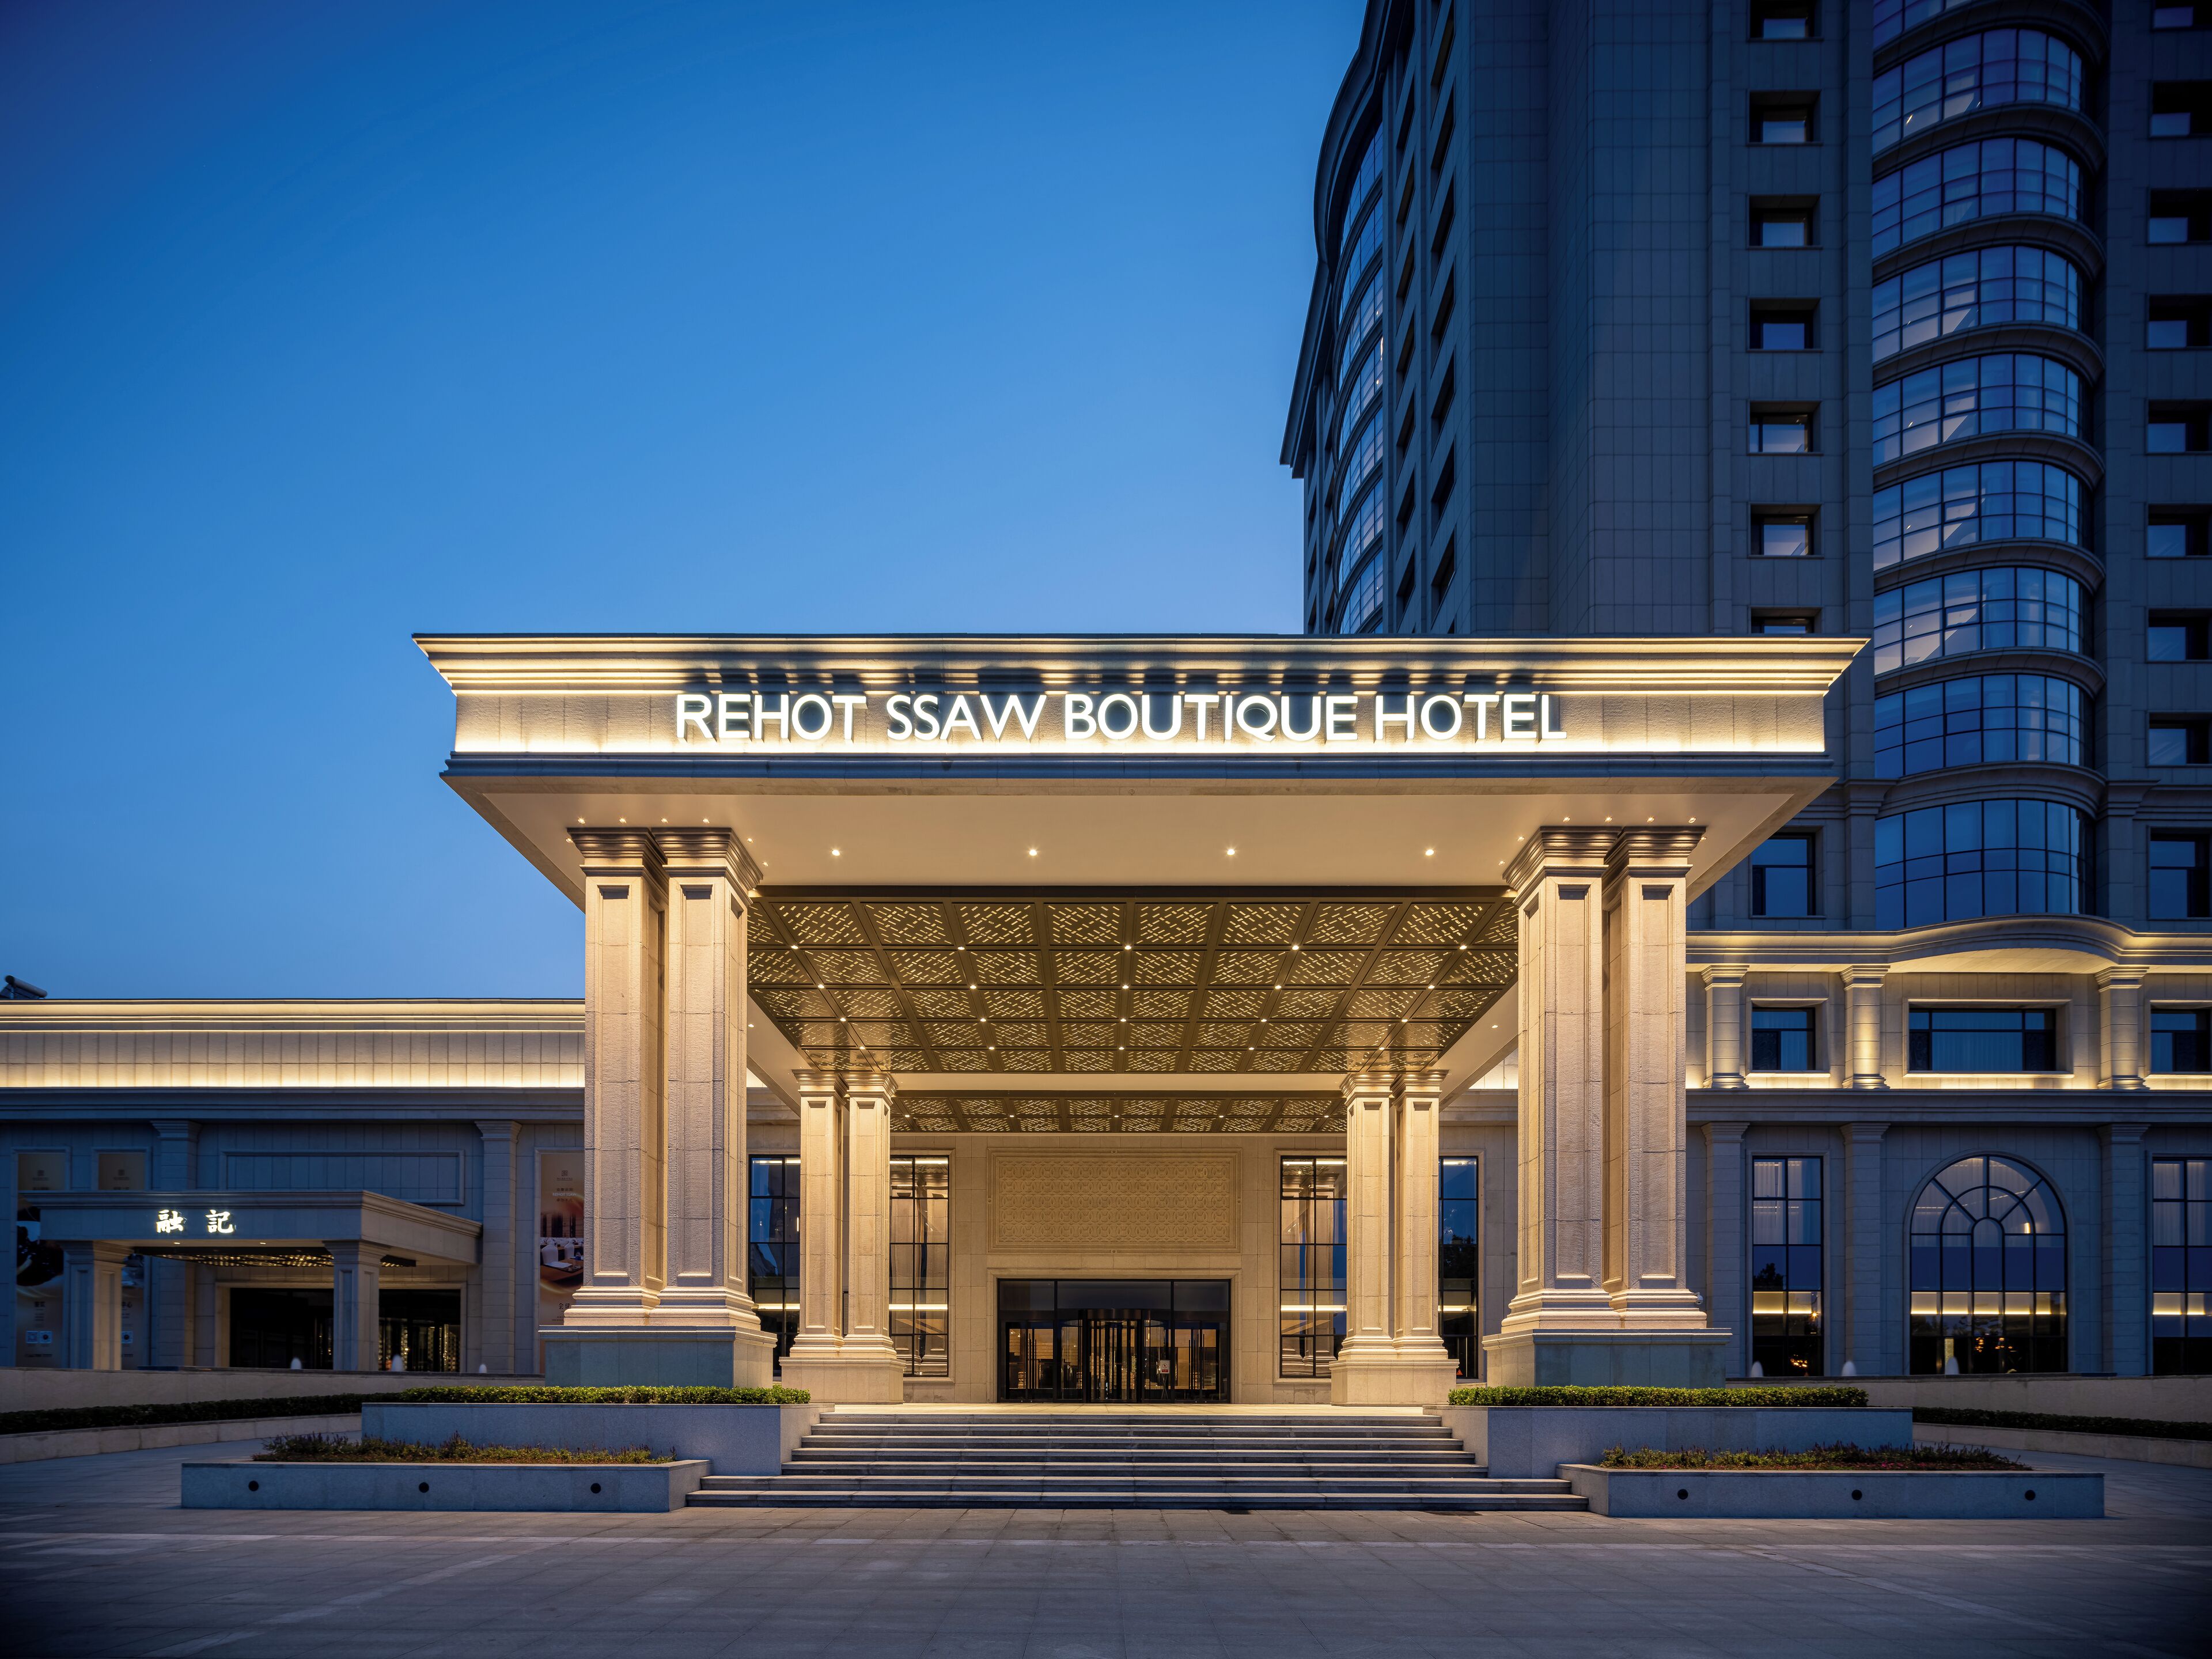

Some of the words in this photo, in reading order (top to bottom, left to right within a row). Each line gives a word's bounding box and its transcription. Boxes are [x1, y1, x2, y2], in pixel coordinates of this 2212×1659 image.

[676, 693, 867, 740] REHOT
[887, 694, 1047, 741] SSAW
[1065, 693, 1358, 742] BOUTIQUE
[1374, 694, 1568, 741] HOTEL
[156, 1209, 234, 1233] 融記
